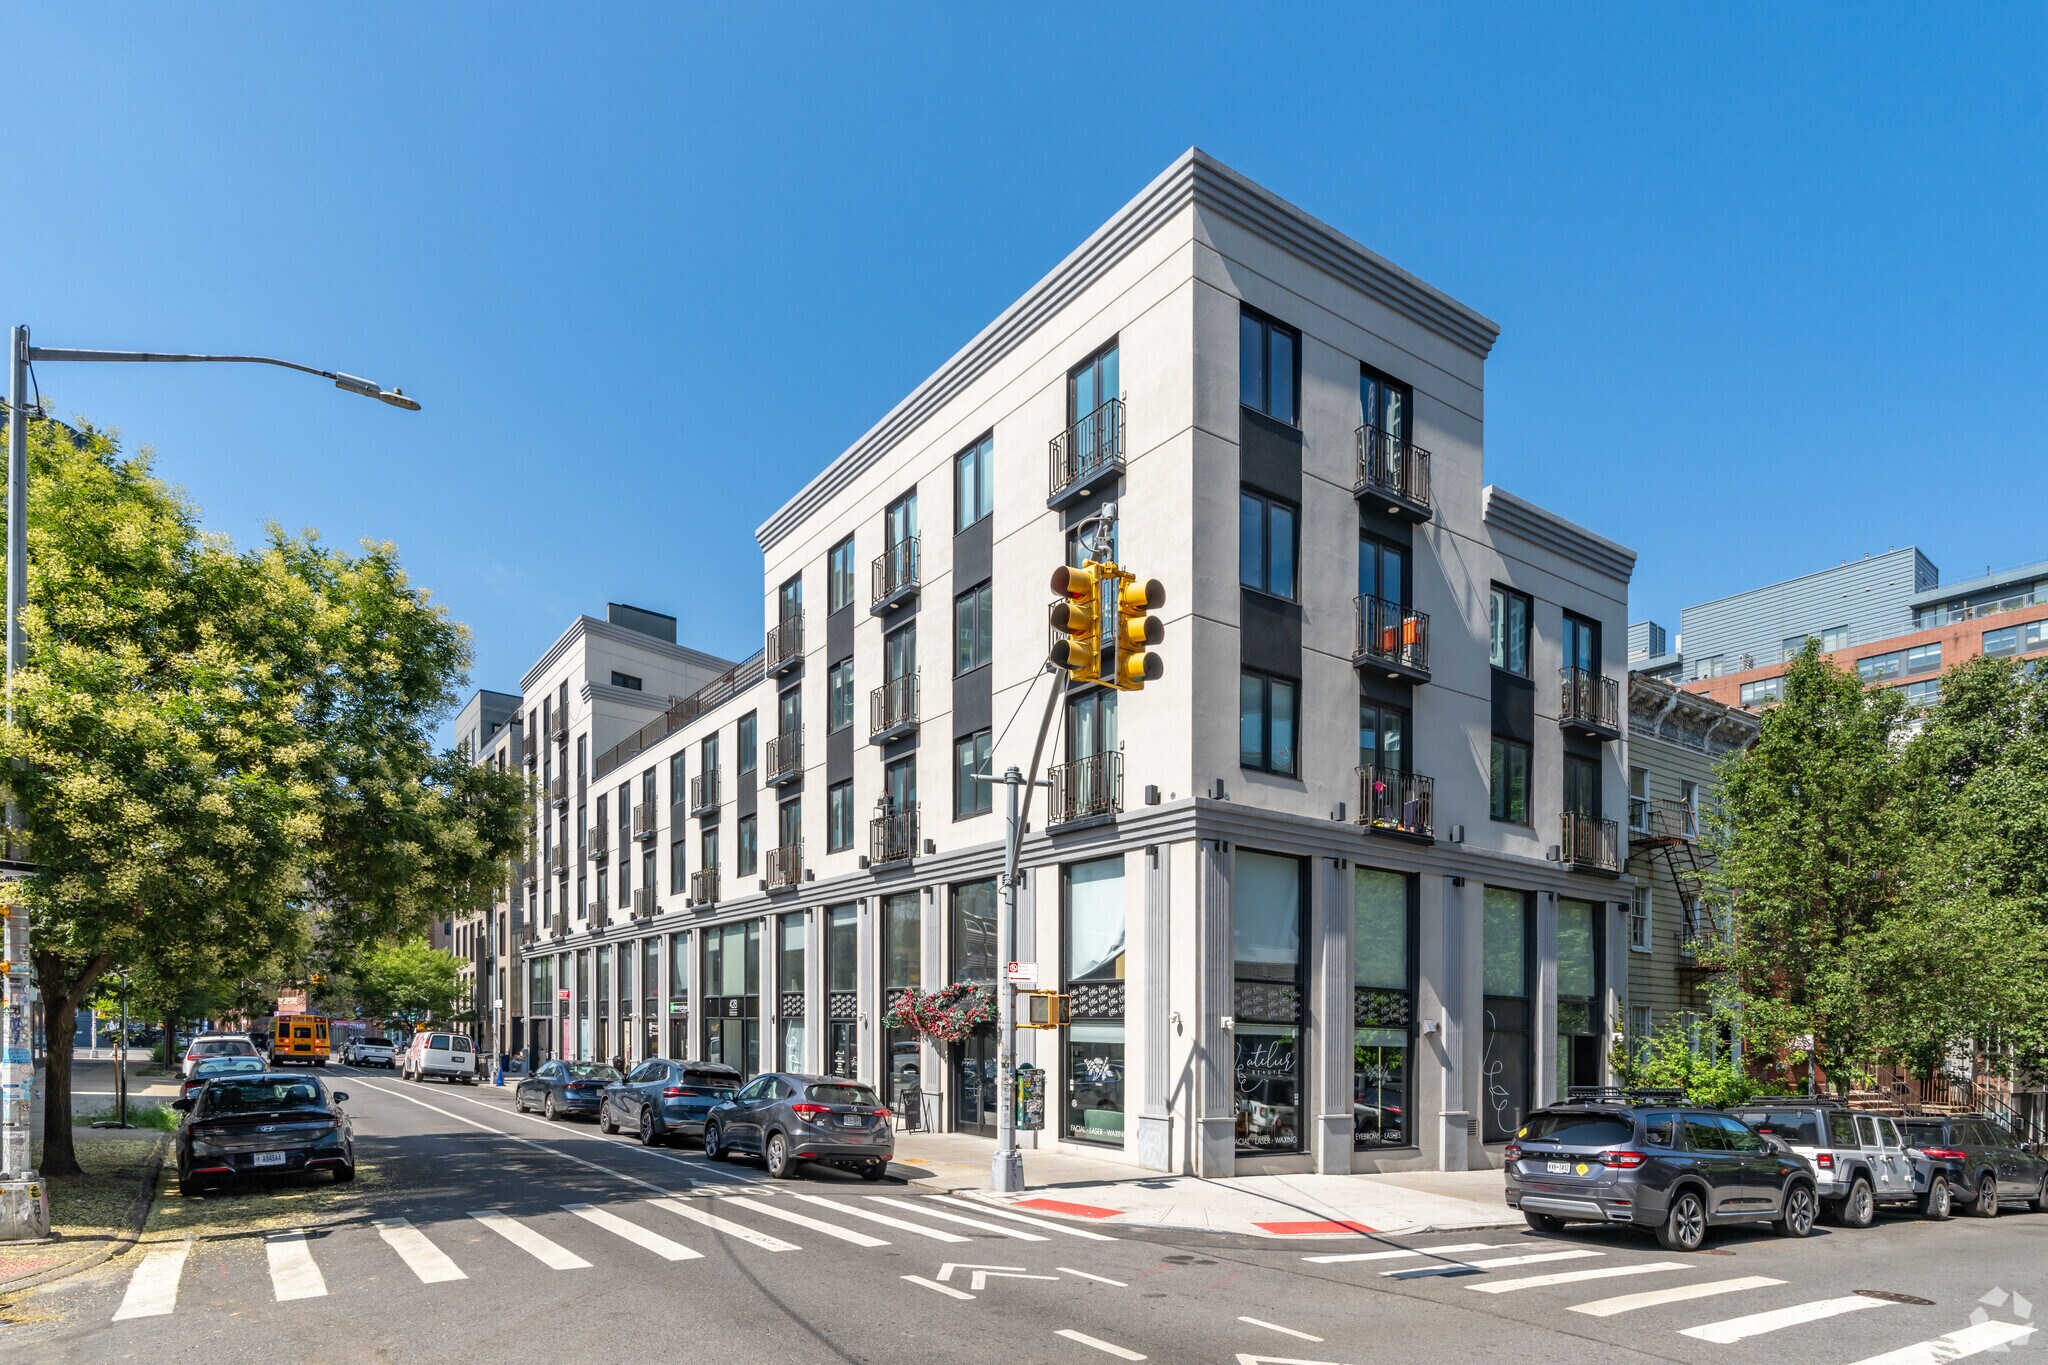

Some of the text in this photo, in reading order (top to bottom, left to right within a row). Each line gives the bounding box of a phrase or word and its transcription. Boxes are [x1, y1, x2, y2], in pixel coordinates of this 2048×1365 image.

[729, 999, 738, 1009] 428
[1070, 1125, 1125, 1138] FACIAL LASER WAXIN
[1355, 1131, 1402, 1141] EYEBROWS LASHES
[1235, 1135, 1298, 1146] ACIAL LASER WAXING
